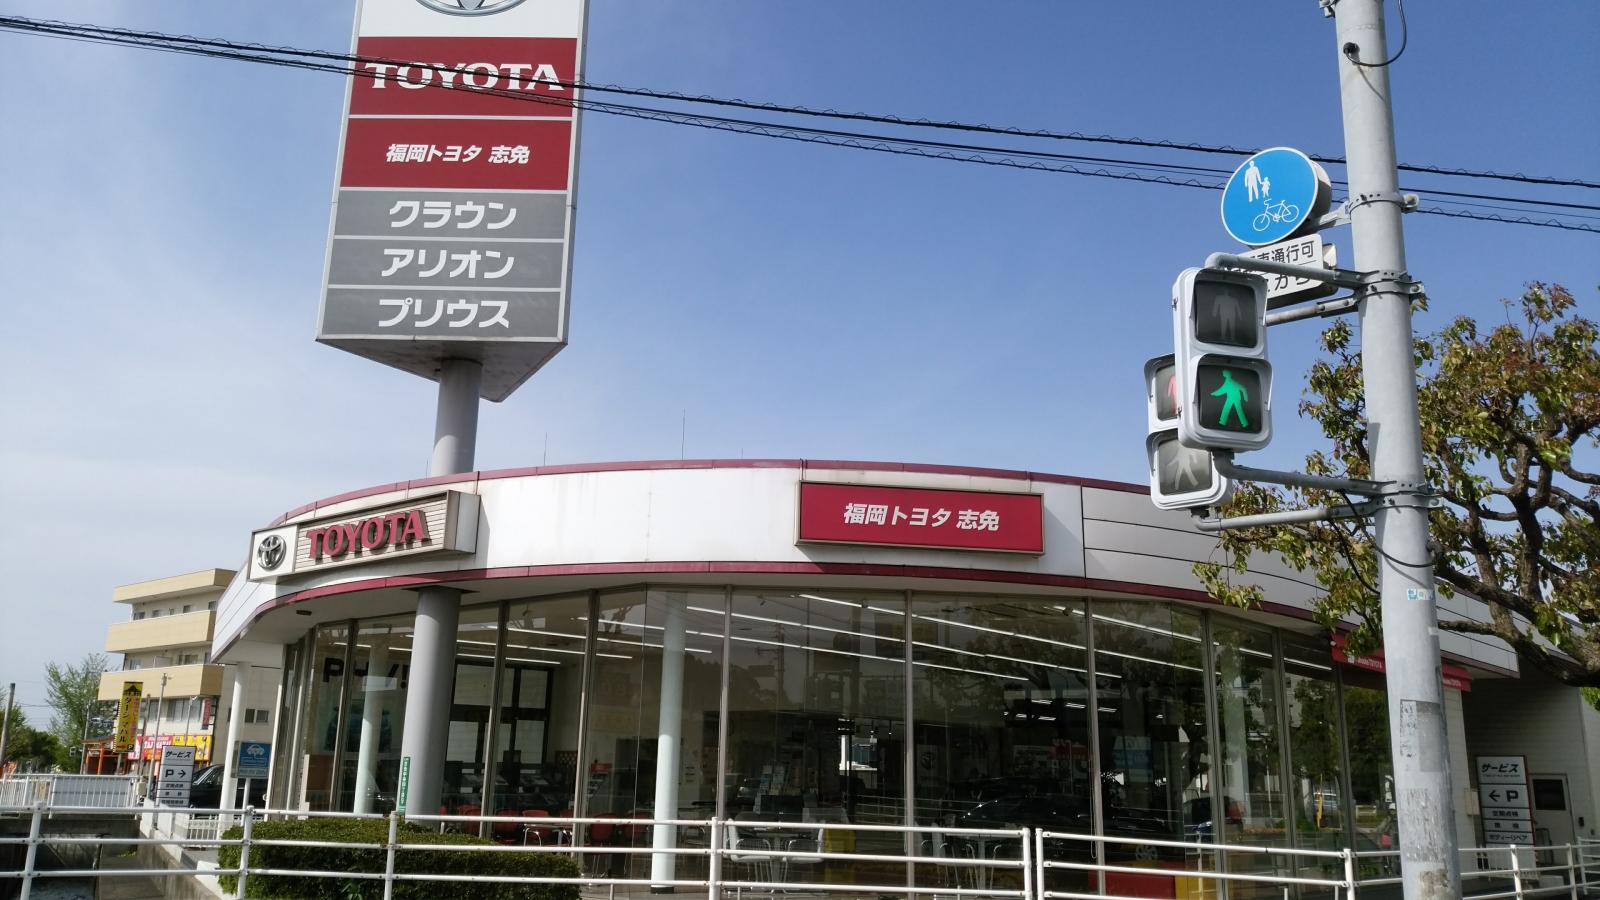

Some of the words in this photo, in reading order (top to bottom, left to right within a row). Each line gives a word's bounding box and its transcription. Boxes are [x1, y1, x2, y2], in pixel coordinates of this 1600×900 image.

[365, 62, 564, 91] TOYOTA
[386, 144, 482, 163] 福岡トヨタ
[488, 146, 530, 164] 志免
[389, 201, 517, 230] クラウン
[381, 248, 515, 279] アリオン
[378, 297, 510, 329] プリウス
[843, 503, 951, 527] 福岡トヨタ
[956, 509, 1000, 531] 志免
[306, 509, 430, 560] TOYOTA
[165, 750, 192, 758] サービス
[1481, 763, 1519, 773] サービス
[165, 769, 174, 777] P
[1506, 790, 1519, 802] P
